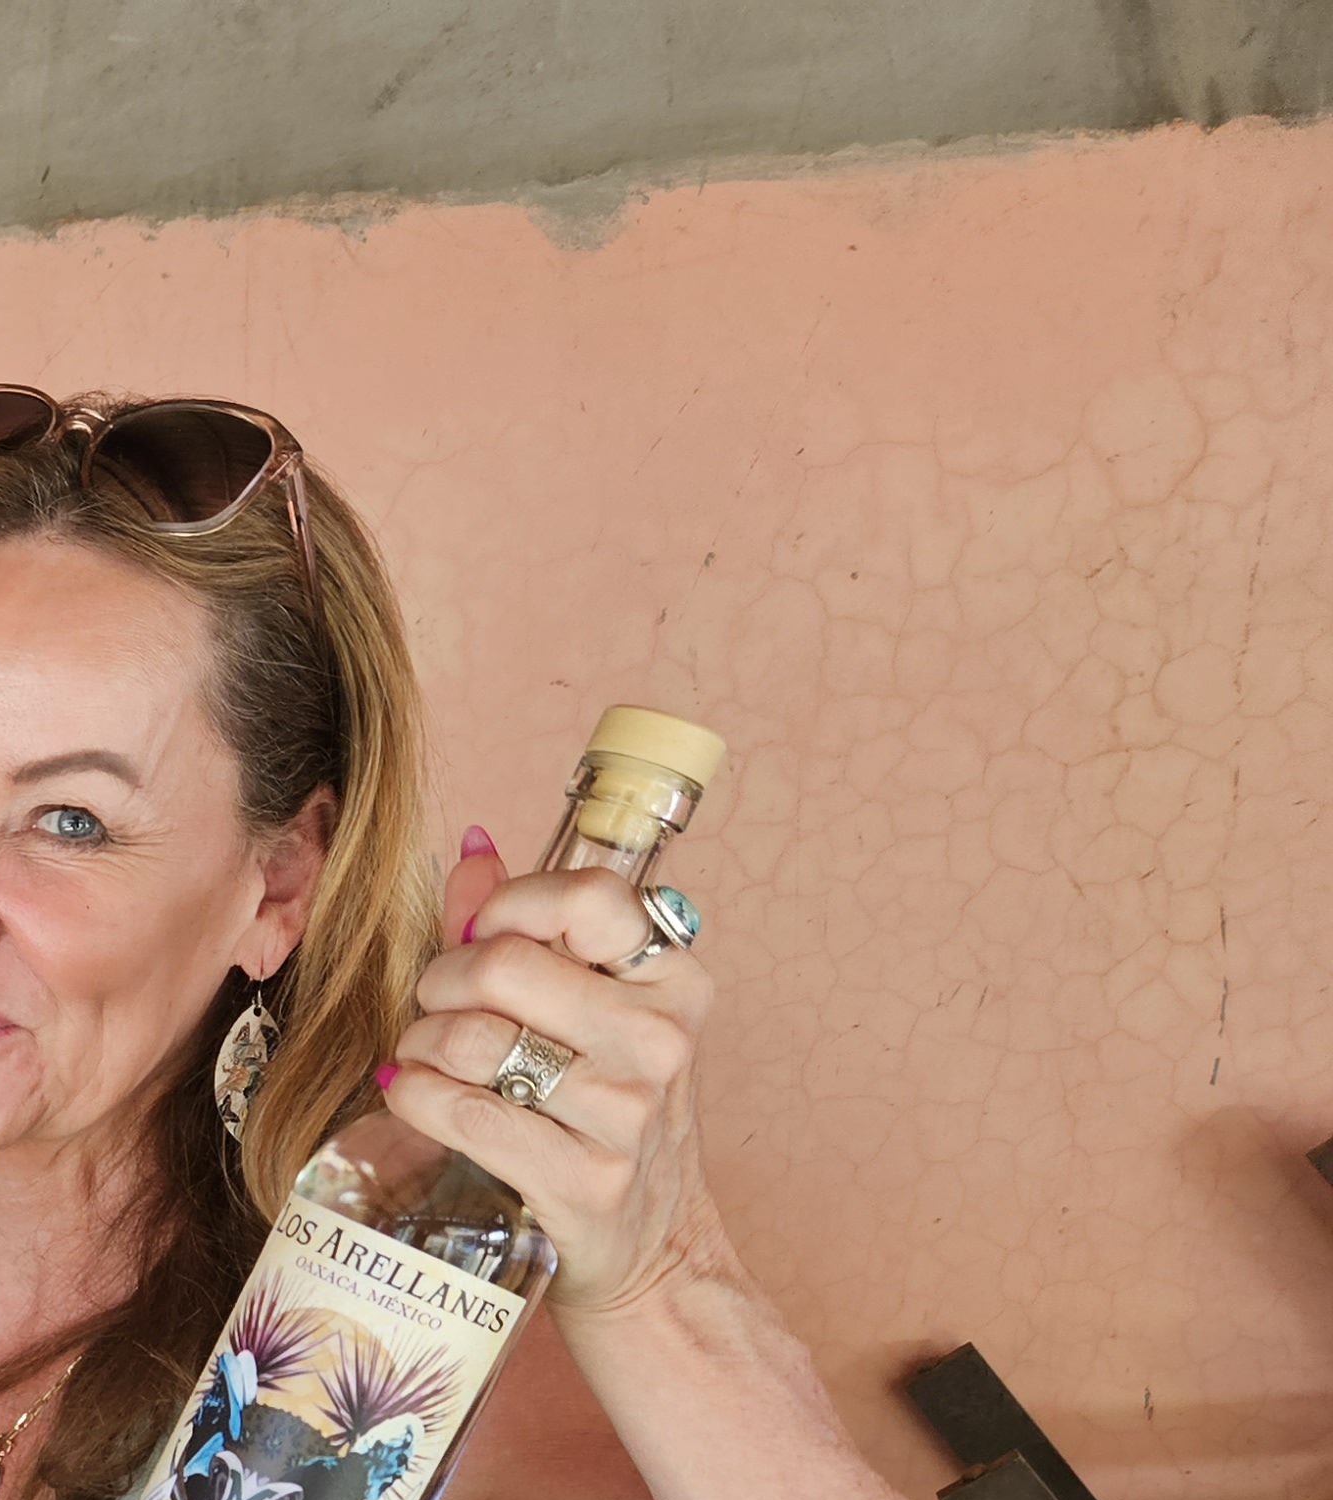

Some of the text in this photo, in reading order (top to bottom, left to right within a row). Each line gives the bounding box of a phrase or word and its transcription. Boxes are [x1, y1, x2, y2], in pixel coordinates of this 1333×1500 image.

[276, 1203, 510, 1333] LOS ARELLANES
[295, 1256, 443, 1331] OAXACA, MÉXICO
